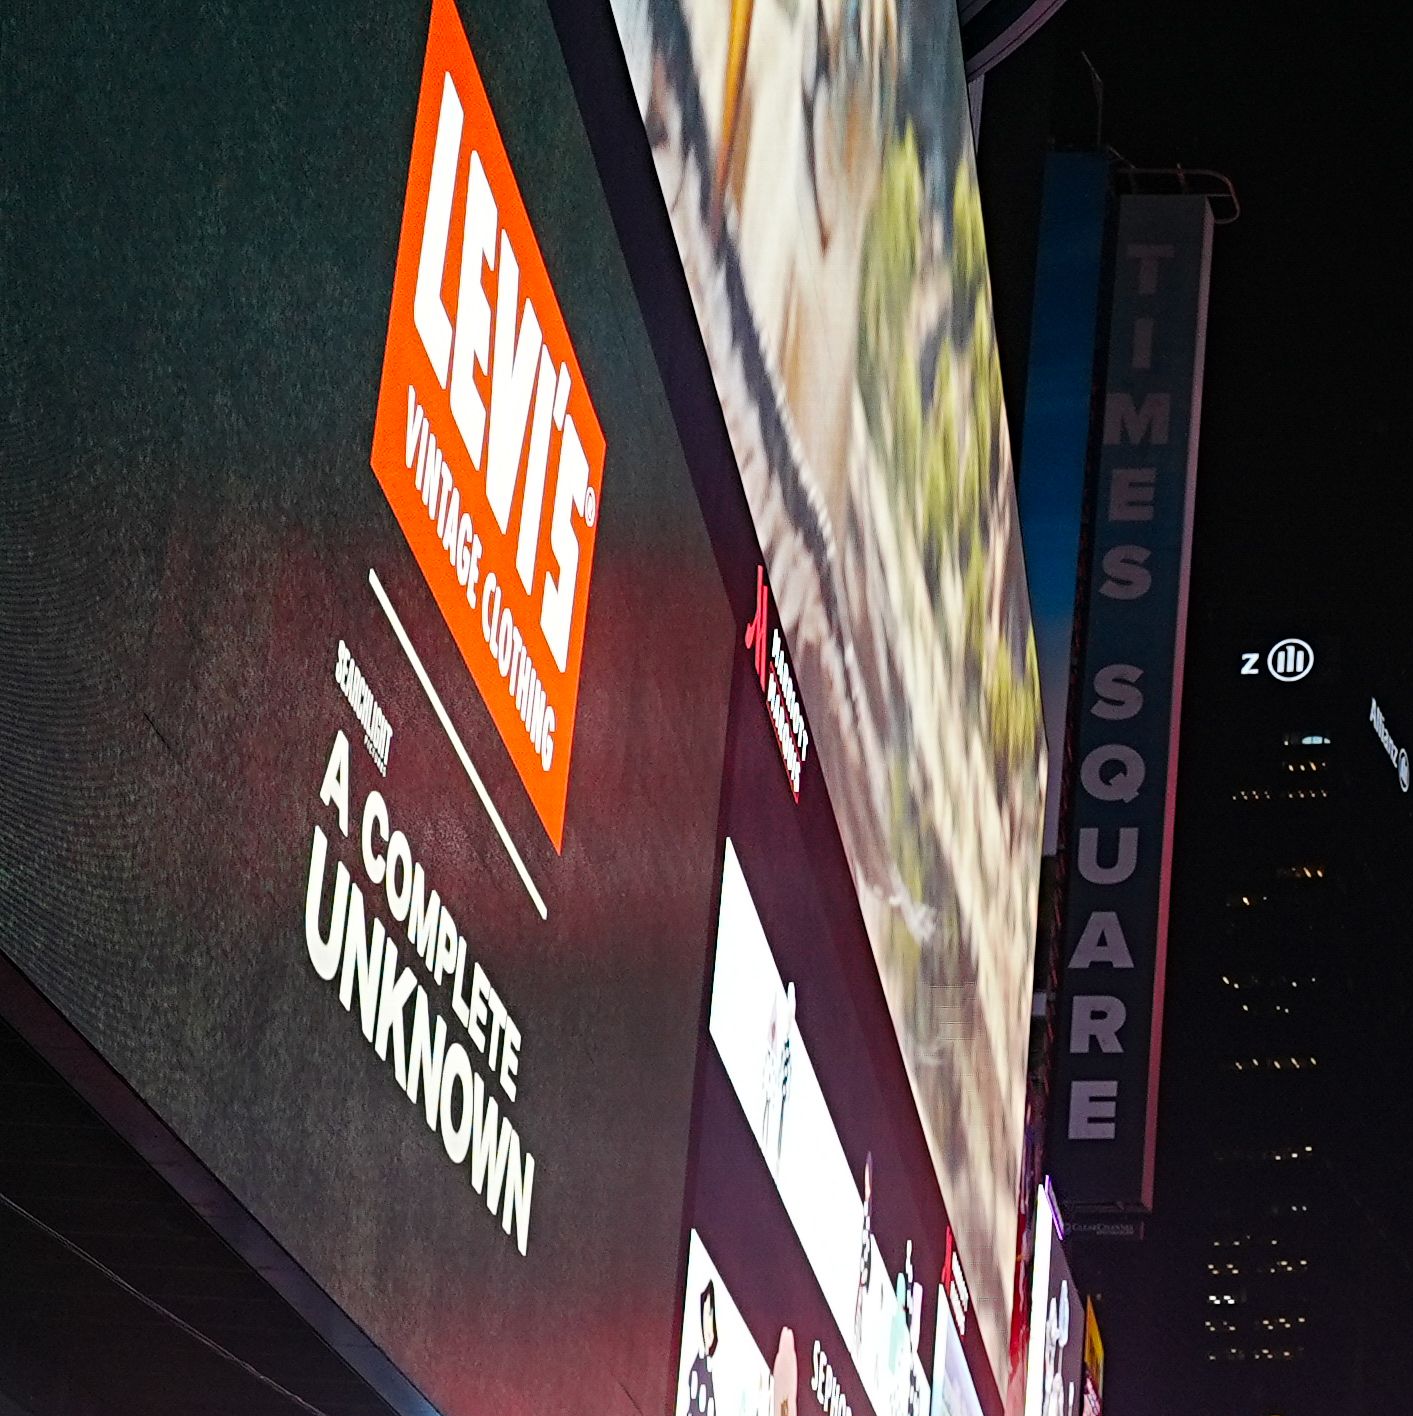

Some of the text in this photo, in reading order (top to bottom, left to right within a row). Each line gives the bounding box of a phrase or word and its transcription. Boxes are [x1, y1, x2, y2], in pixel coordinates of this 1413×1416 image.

[413, 71, 590, 672] LEVI'S
[1100, 244, 1174, 599] TIMES
[406, 384, 556, 772] VINTAGE CLOTHING
[1370, 696, 1398, 769] Allianz
[304, 826, 535, 1257] UNKNOWN
[320, 730, 522, 1102] A COMPLETE
[1066, 663, 1146, 1140] SQUARE
